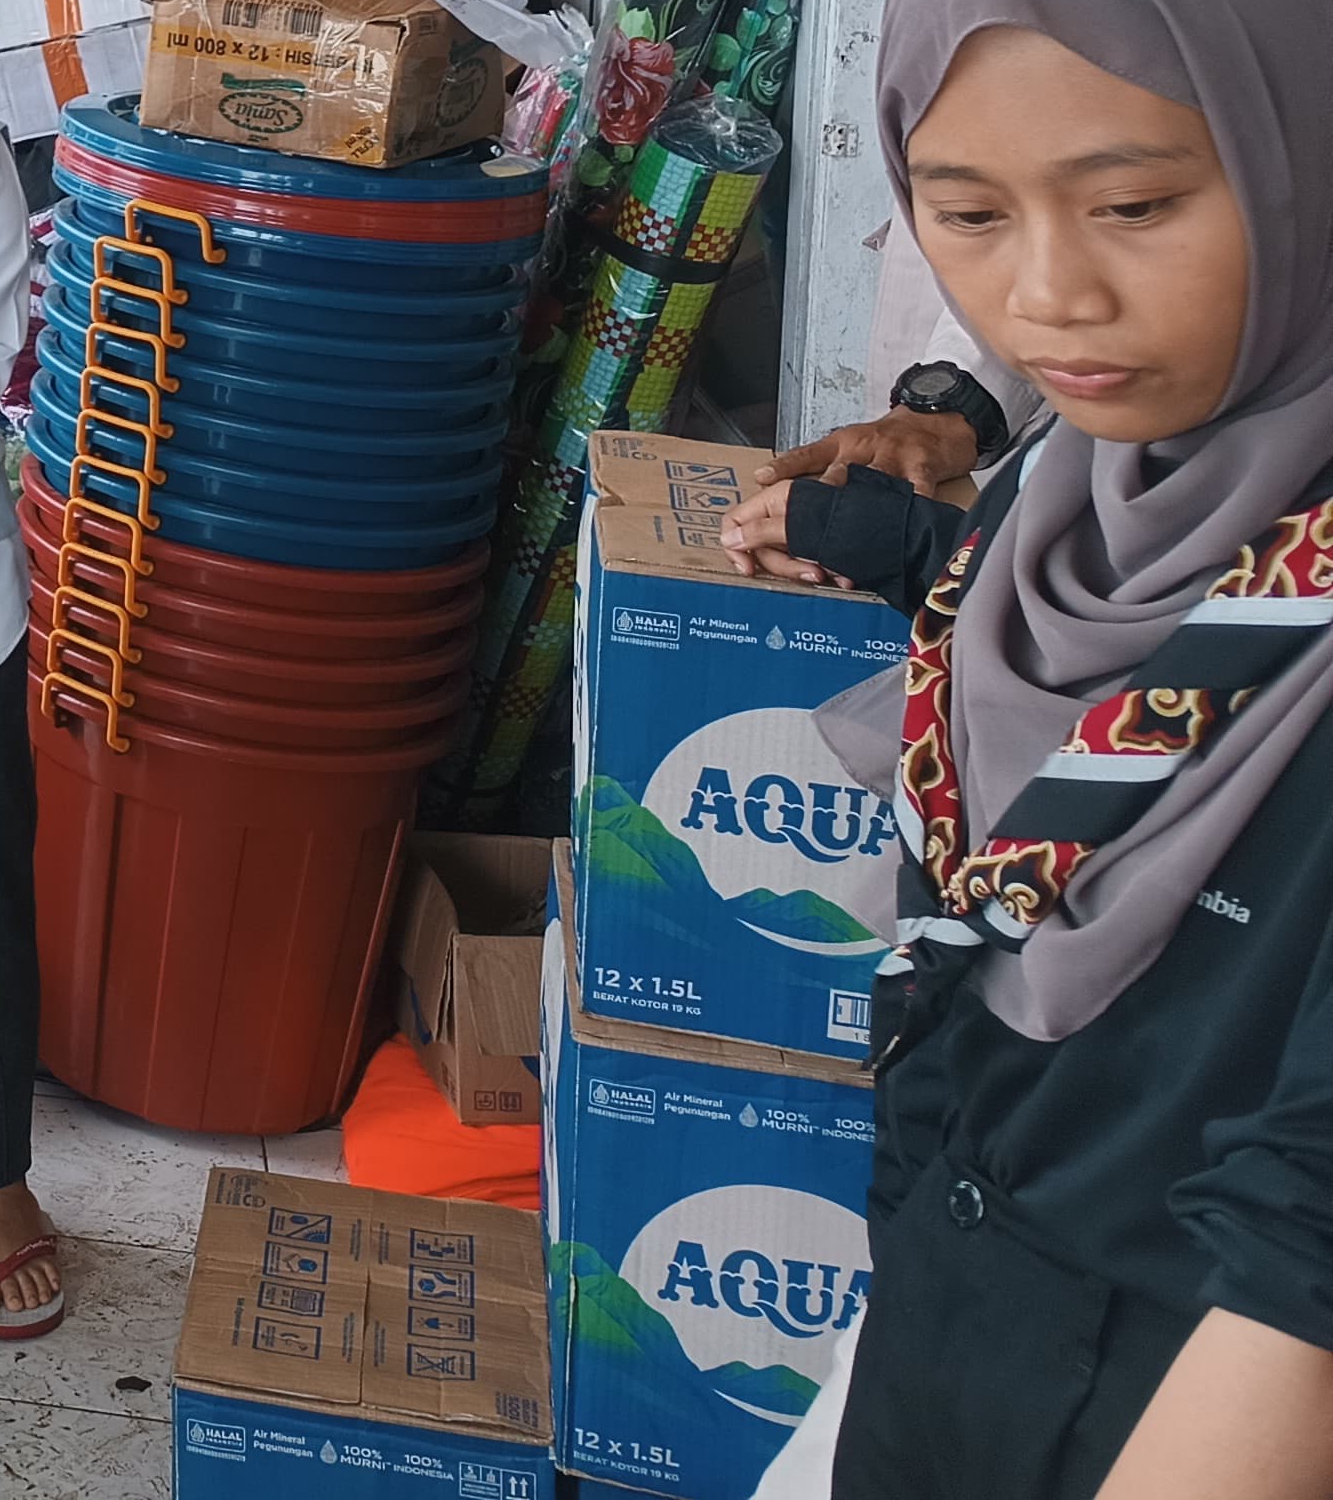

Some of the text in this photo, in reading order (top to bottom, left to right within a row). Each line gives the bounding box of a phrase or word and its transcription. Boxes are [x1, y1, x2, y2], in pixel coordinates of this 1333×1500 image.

[167, 32, 189, 48] ml
[194, 36, 227, 56] 800
[232, 41, 243, 54] x
[248, 45, 270, 62] 12
[235, 99, 289, 127] Sania
[635, 615, 677, 630] HALAL
[689, 617, 749, 631] Air Mineral
[689, 627, 758, 645] Pegunungan
[793, 630, 839, 645] 100%
[864, 639, 909, 653] 100%
[680, 766, 898, 863] AQUA
[594, 967, 702, 1000] 12 x 1.5L
[593, 991, 628, 1005] BERAT
[631, 997, 669, 1011] KOTOR
[686, 1006, 702, 1016] KG
[611, 1089, 653, 1104] HALAL
[664, 1091, 723, 1108] Air Mineral
[664, 1102, 731, 1121] Pegunungan
[766, 1108, 810, 1124] 100%
[657, 1240, 873, 1338] AQUA
[205, 1427, 243, 1442] HALAL
[254, 1429, 305, 1445] Air Mineral
[253, 1439, 313, 1458] Pegunungan
[343, 1445, 383, 1460] 100%
[574, 1427, 680, 1468] 12 x 1.5L
[404, 1454, 443, 1469] 100%
[573, 1450, 608, 1466] BERAT
[610, 1461, 648, 1476] KOTOR
[664, 1472, 680, 1482] KG
[393, 1463, 454, 1481] INDONESIA
